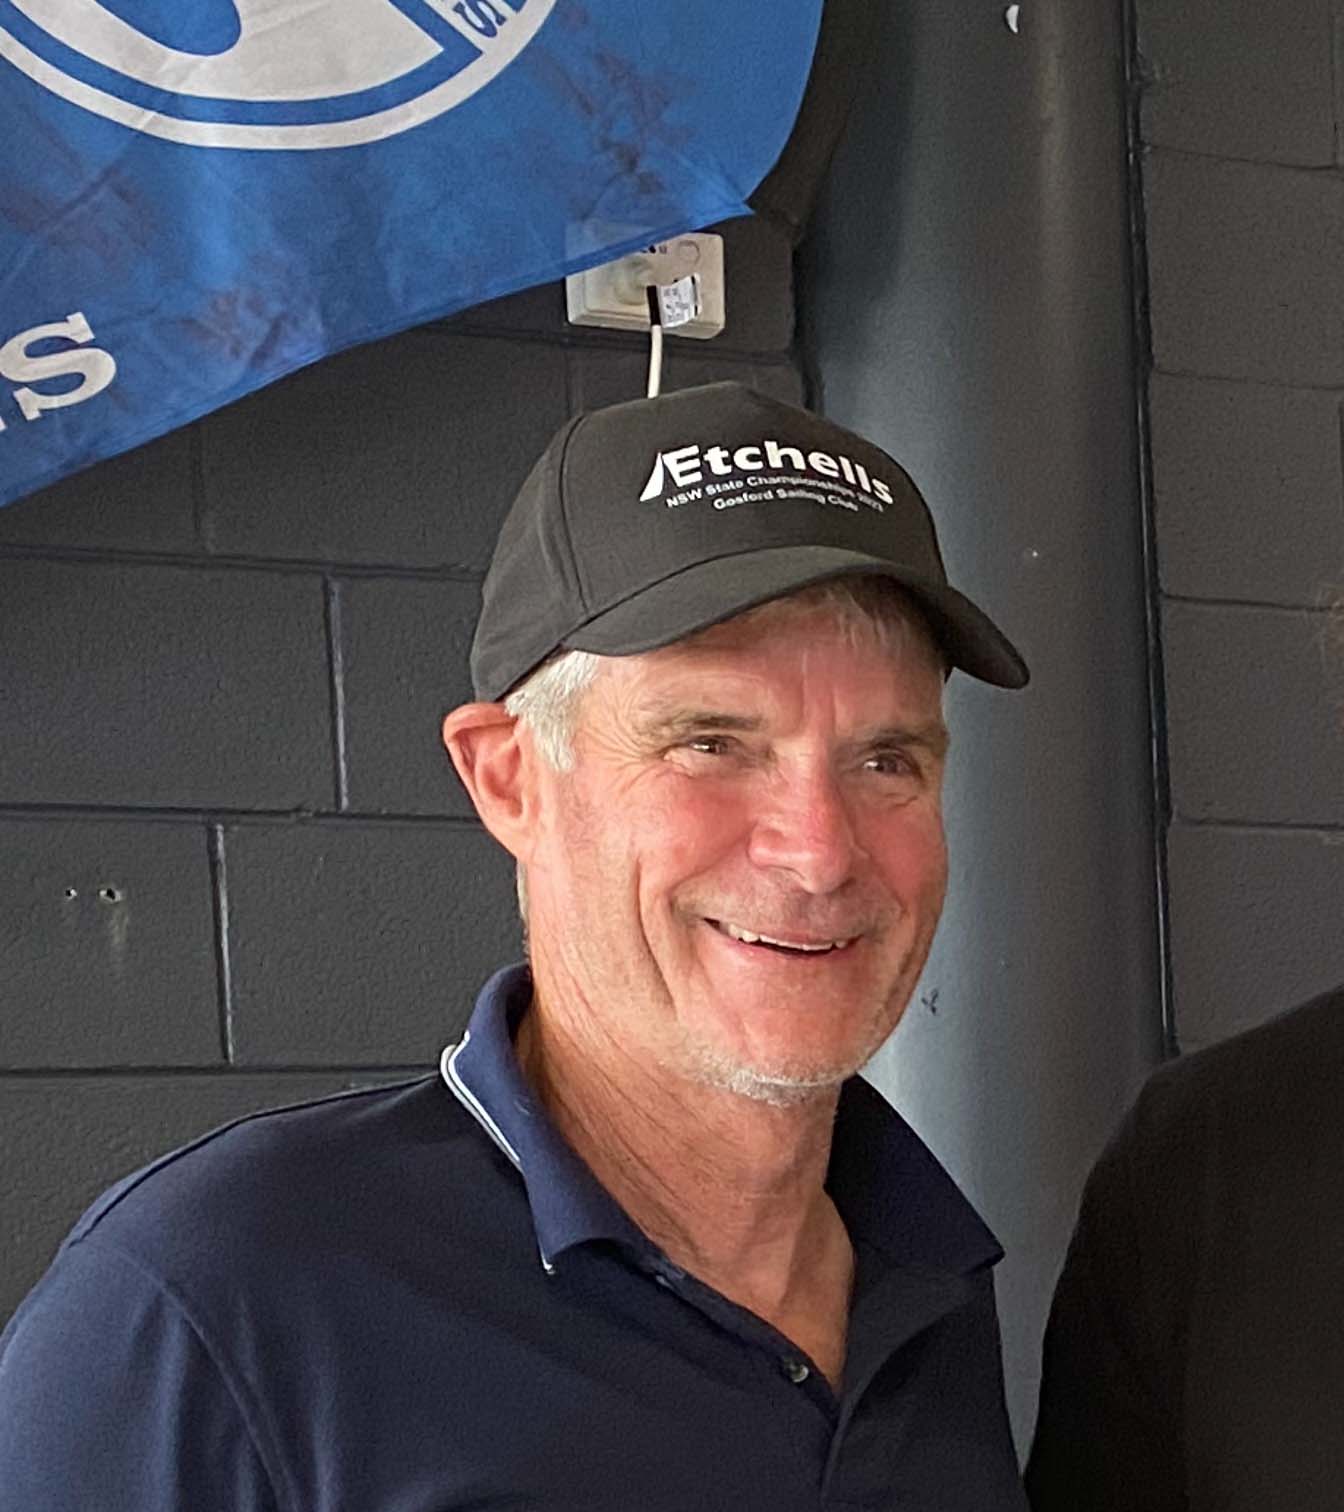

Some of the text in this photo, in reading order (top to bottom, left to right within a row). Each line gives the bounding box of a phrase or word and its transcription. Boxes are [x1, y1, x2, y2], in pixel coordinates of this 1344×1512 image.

[667, 487, 702, 509] NSW
[705, 479, 743, 498] State
[713, 489, 773, 511] Gosford
